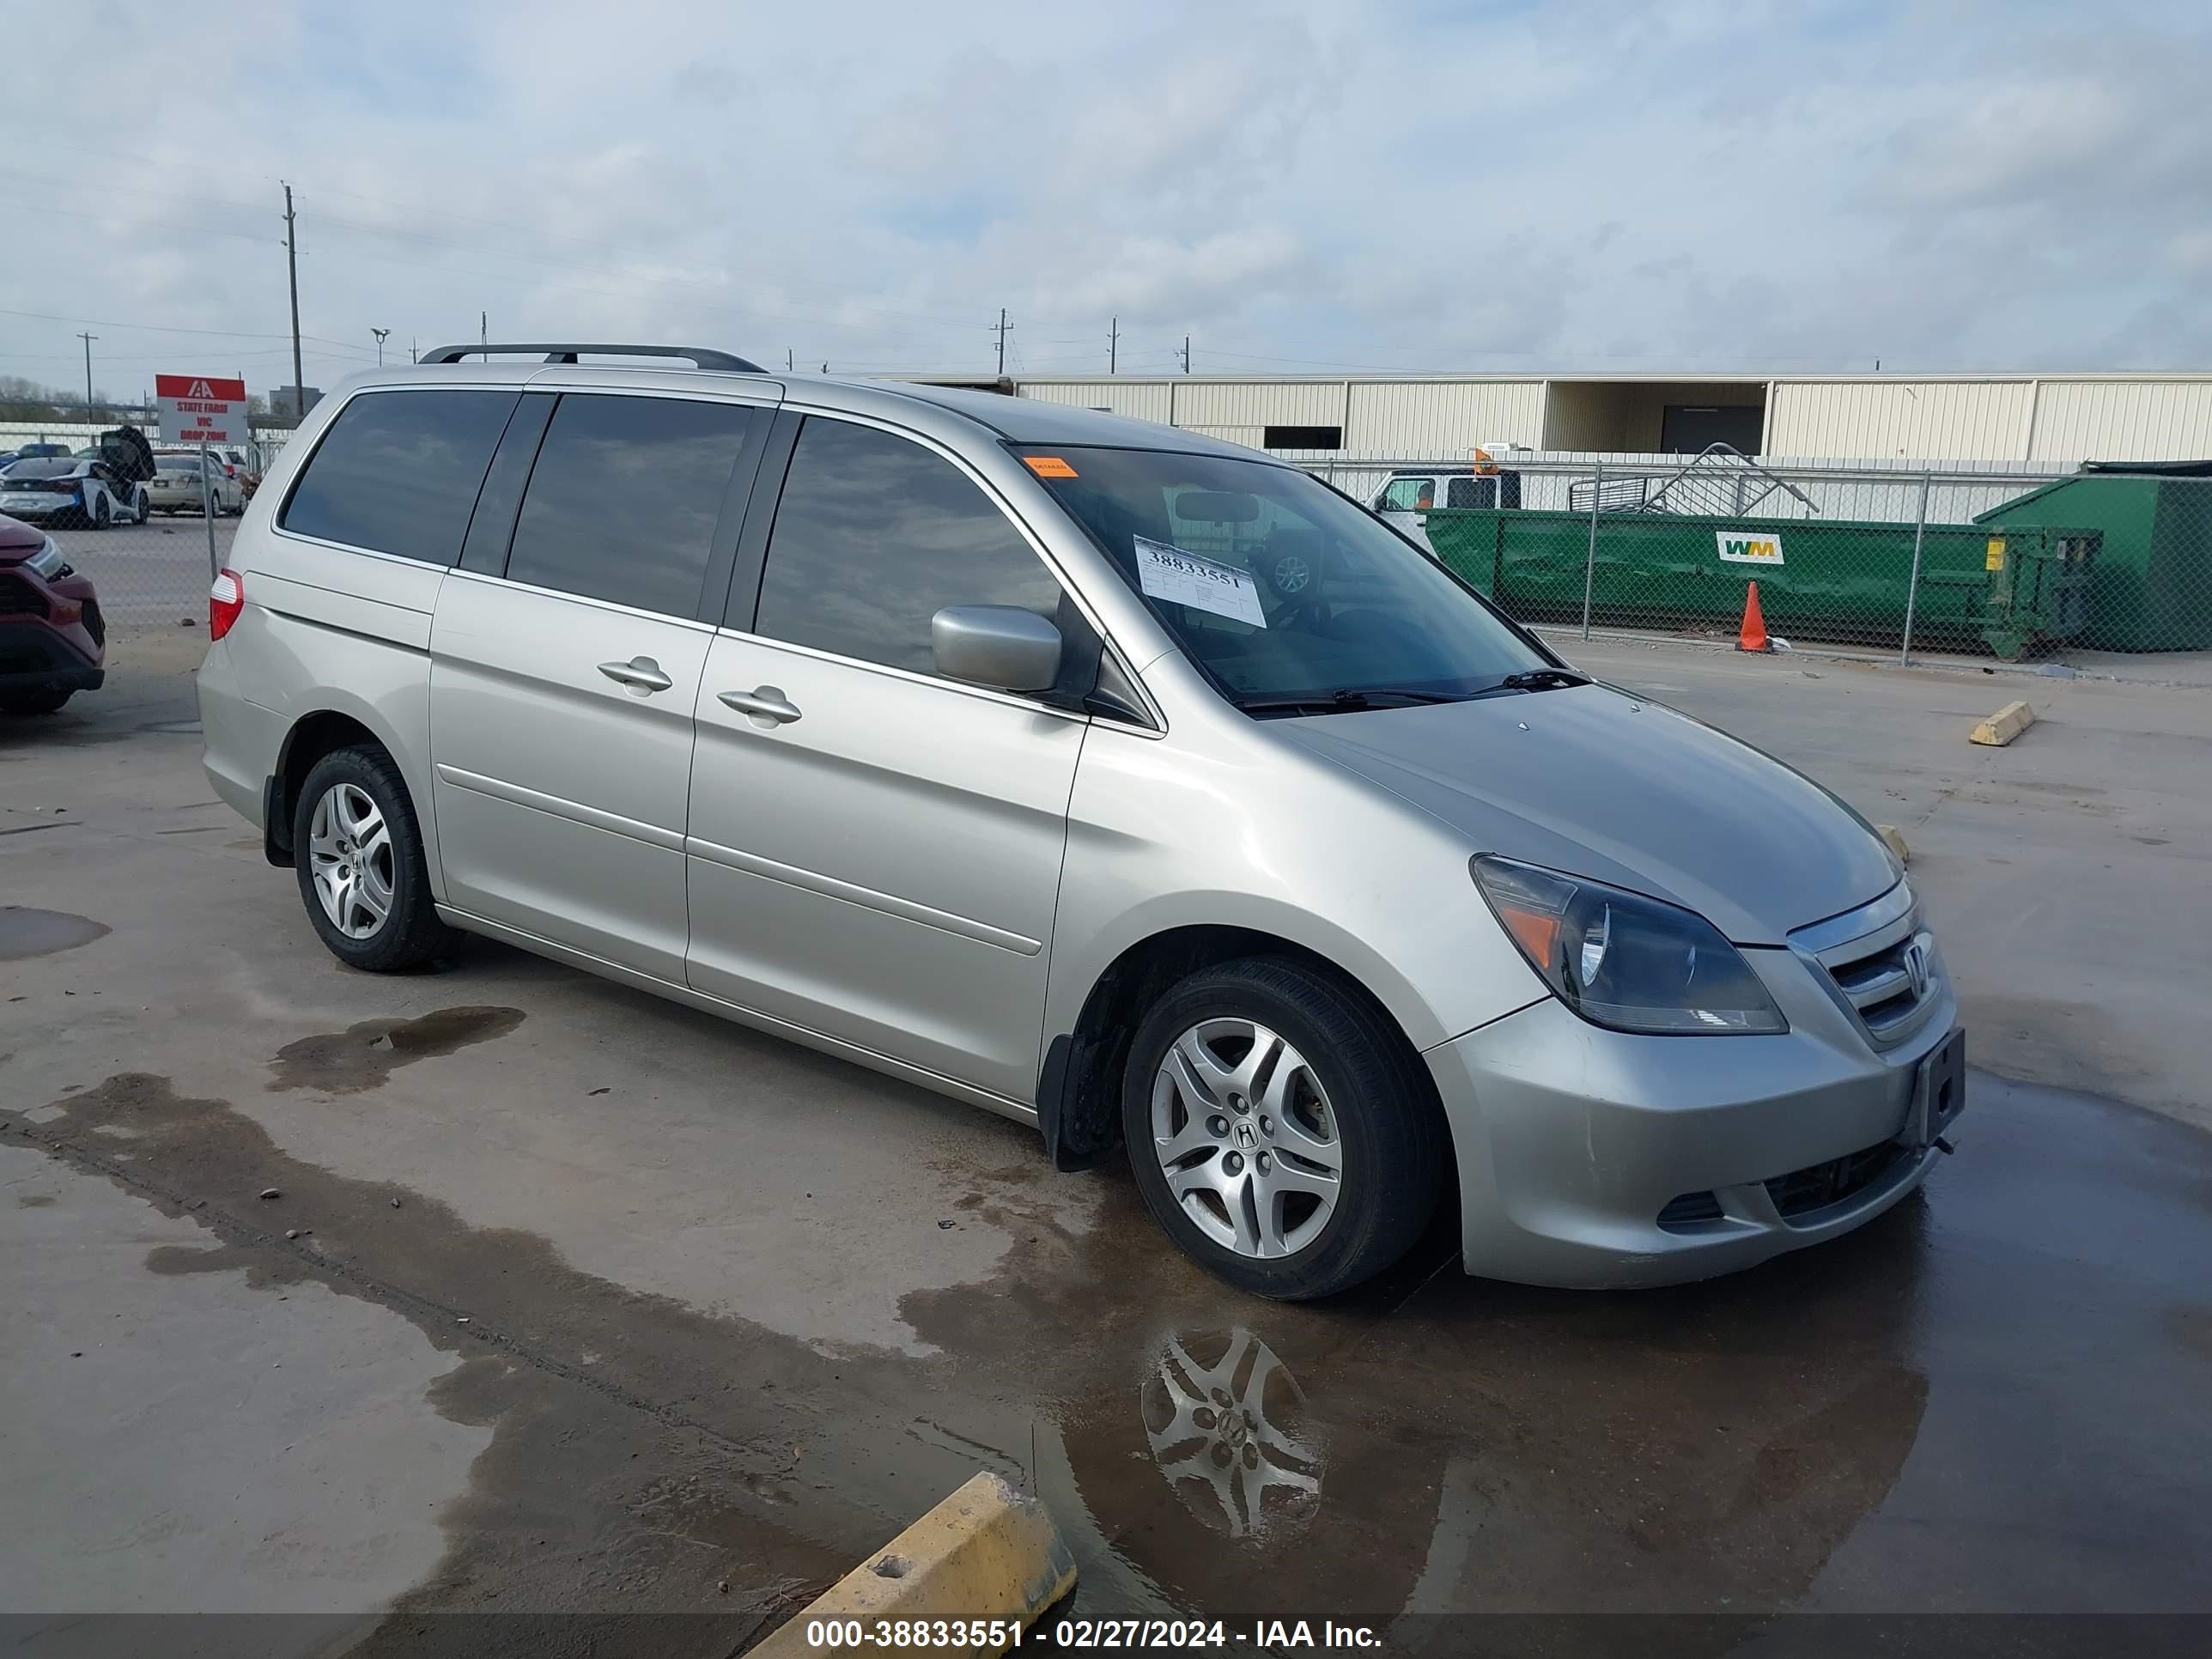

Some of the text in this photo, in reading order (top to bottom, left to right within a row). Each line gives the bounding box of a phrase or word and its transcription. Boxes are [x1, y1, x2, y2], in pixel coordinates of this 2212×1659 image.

[177, 401, 228, 413] STATE FARM
[198, 416, 212, 426] VIC
[180, 429, 228, 441] DROP ZONE
[1725, 540, 1775, 556] WM
[1149, 551, 1240, 588] 38833551
